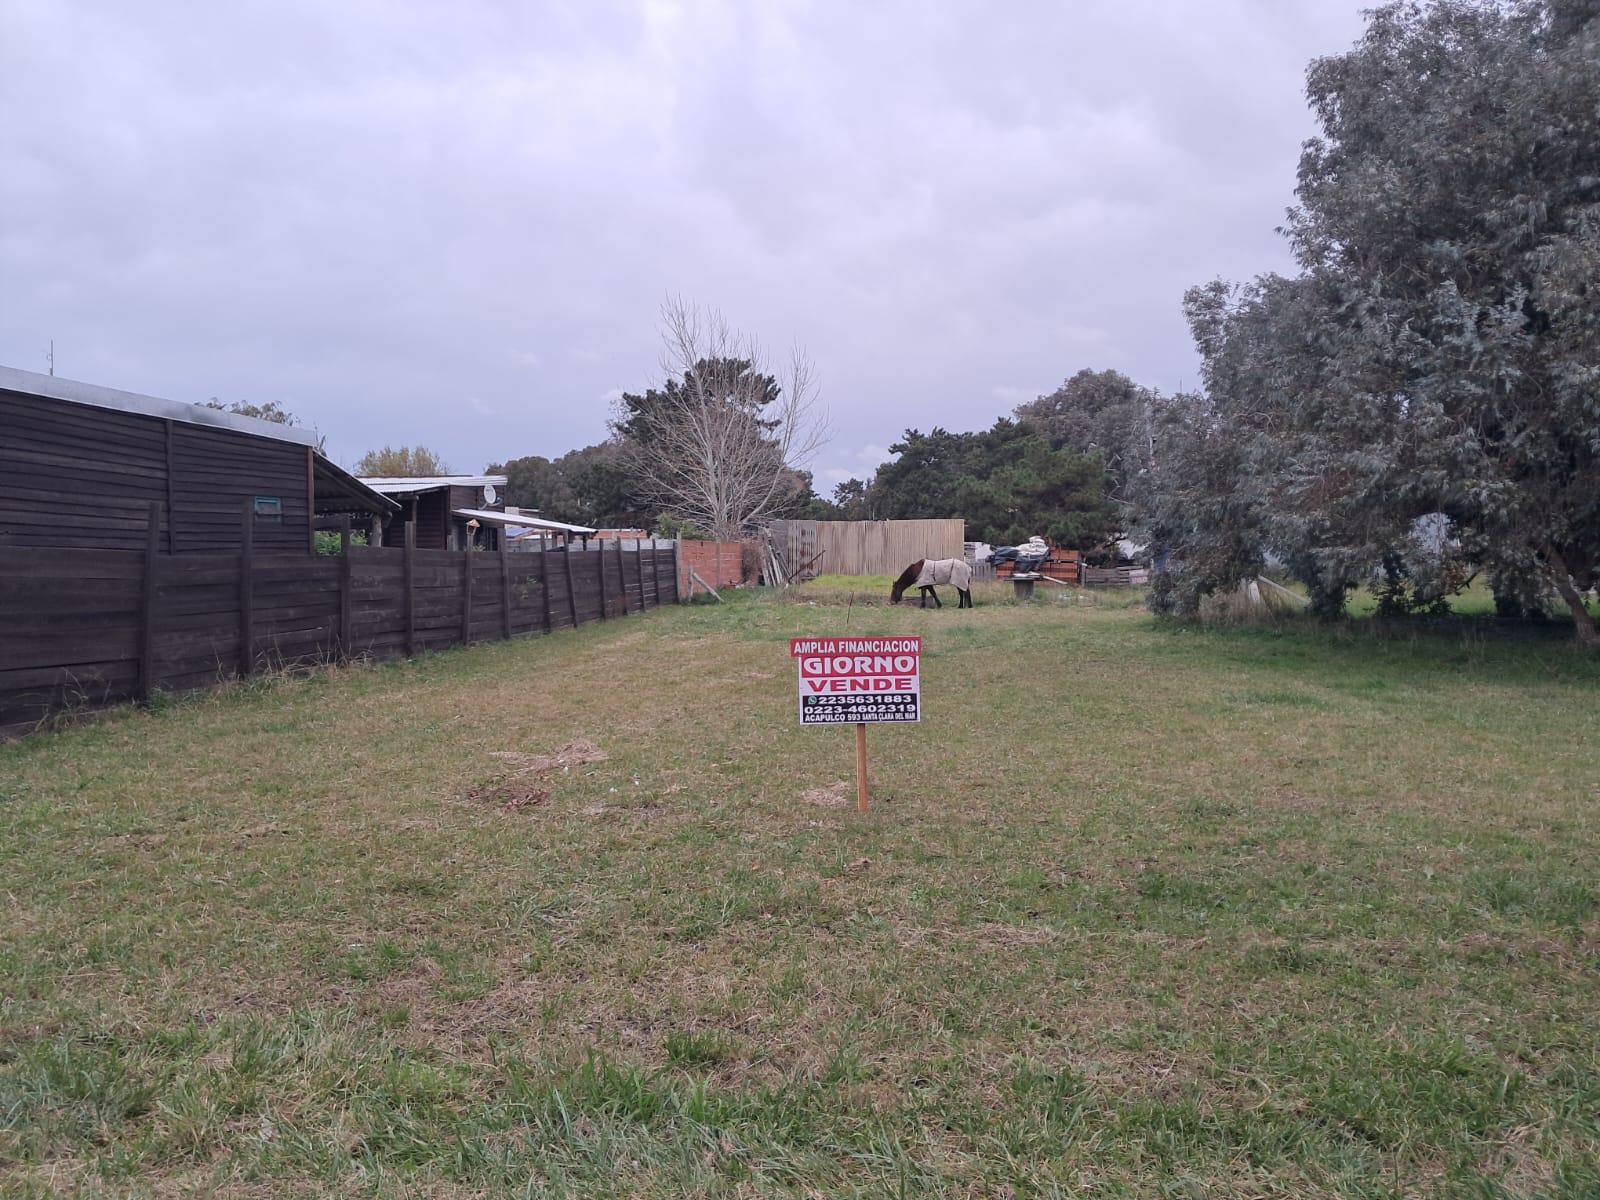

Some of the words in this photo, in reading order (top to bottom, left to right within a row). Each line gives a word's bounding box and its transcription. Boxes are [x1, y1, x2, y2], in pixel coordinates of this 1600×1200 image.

[794, 641, 835, 653] AMPLIA
[839, 640, 918, 653] FINANCIACION
[804, 656, 914, 674] GIORNO
[808, 678, 912, 692] VENDE
[819, 695, 912, 704] 2235631883
[805, 704, 916, 714] 0223-4602319
[805, 714, 845, 722] ACAPULCO
